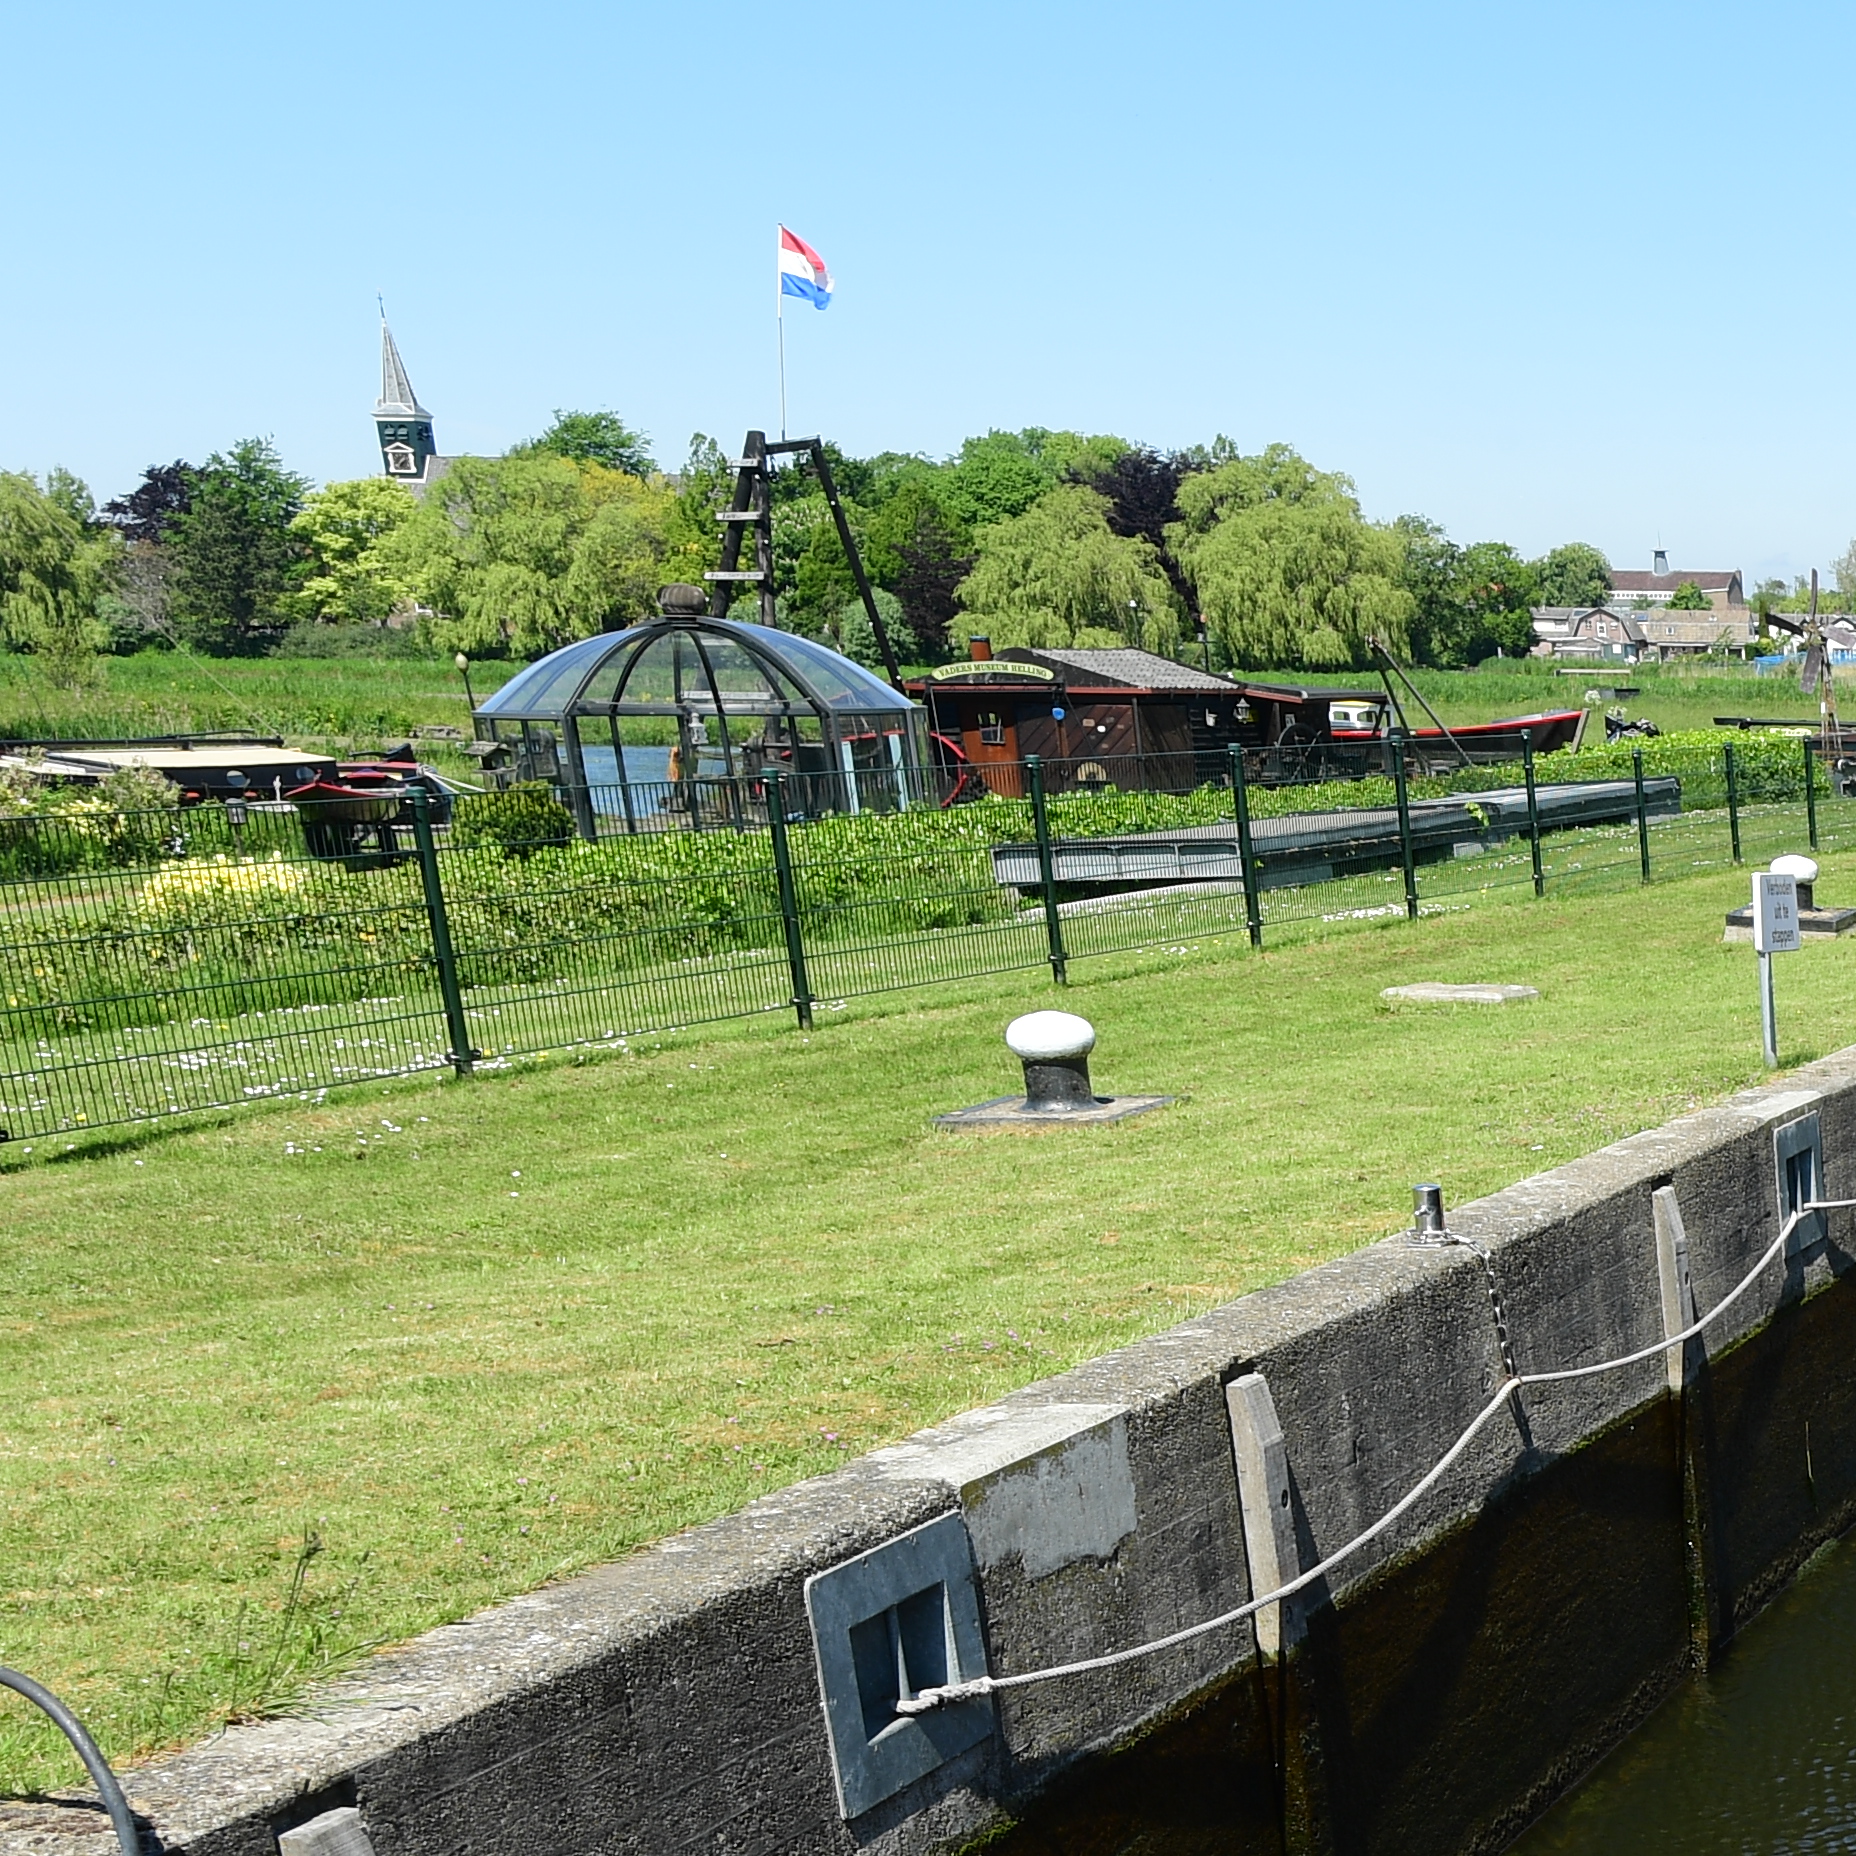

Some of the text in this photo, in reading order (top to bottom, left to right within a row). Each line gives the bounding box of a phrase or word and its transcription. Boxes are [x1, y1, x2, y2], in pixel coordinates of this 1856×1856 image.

[937, 663, 1047, 678] VADERS MUSEUM HELLING
[1766, 877, 1793, 896] Verboden
[1771, 927, 1795, 948] stappen
